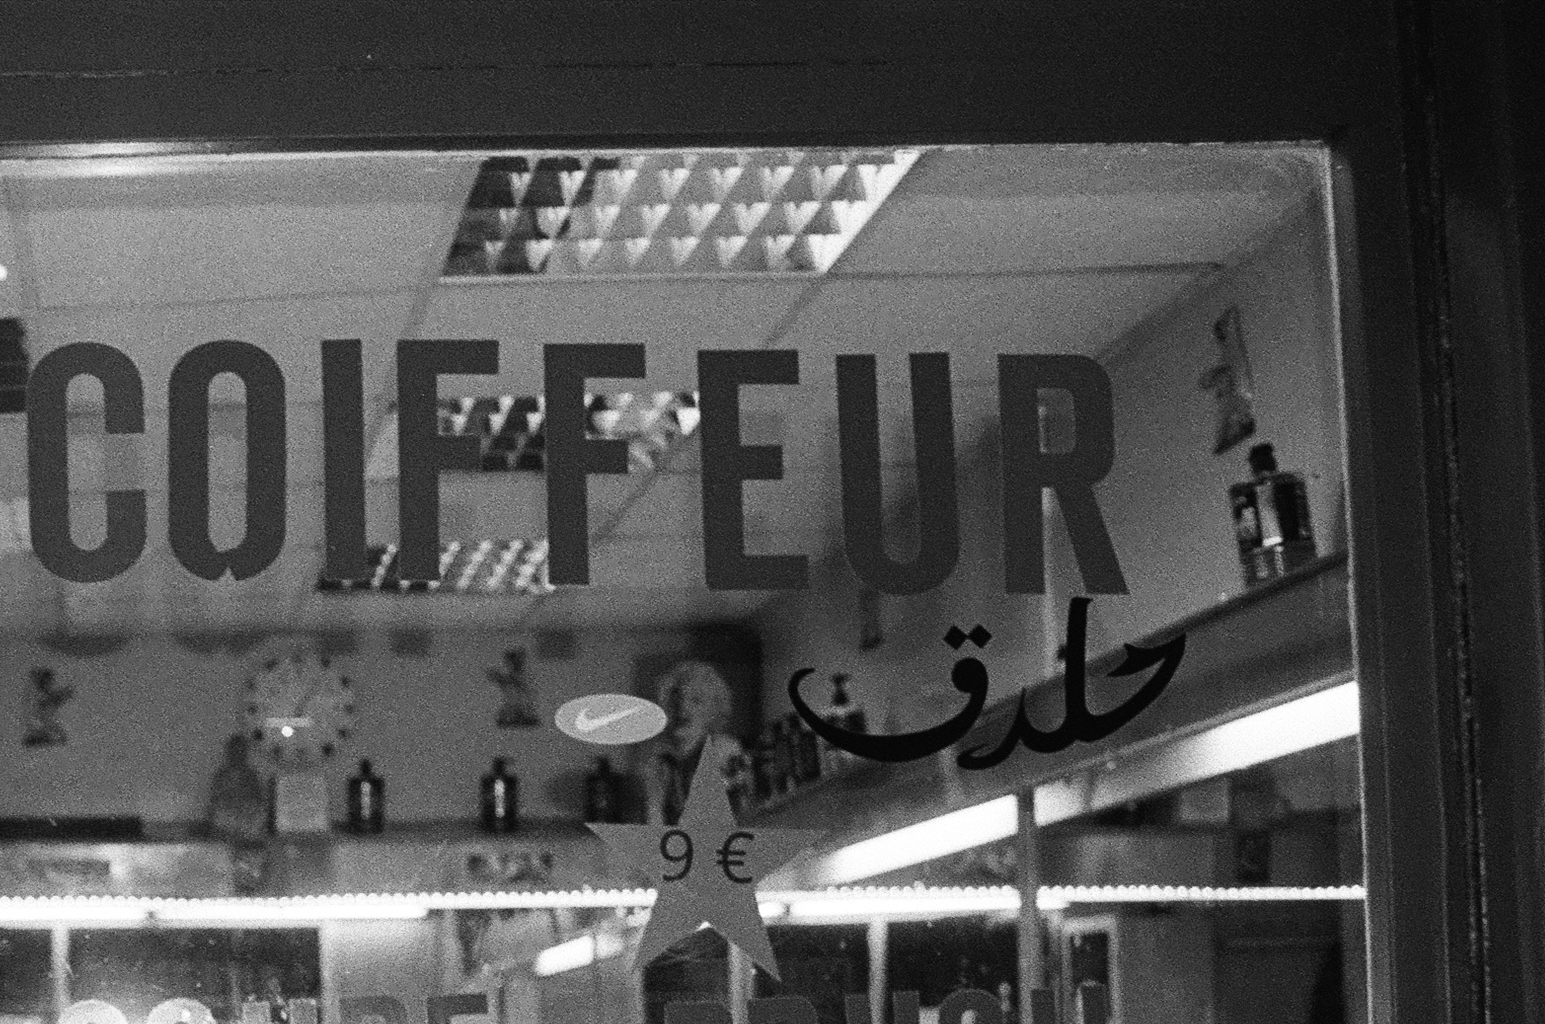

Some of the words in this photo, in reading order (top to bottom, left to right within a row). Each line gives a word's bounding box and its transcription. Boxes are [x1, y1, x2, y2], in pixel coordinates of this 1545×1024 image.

[27, 338, 1129, 597] COIFFEUR
[660, 829, 693, 882] 9
[716, 831, 754, 884] €
